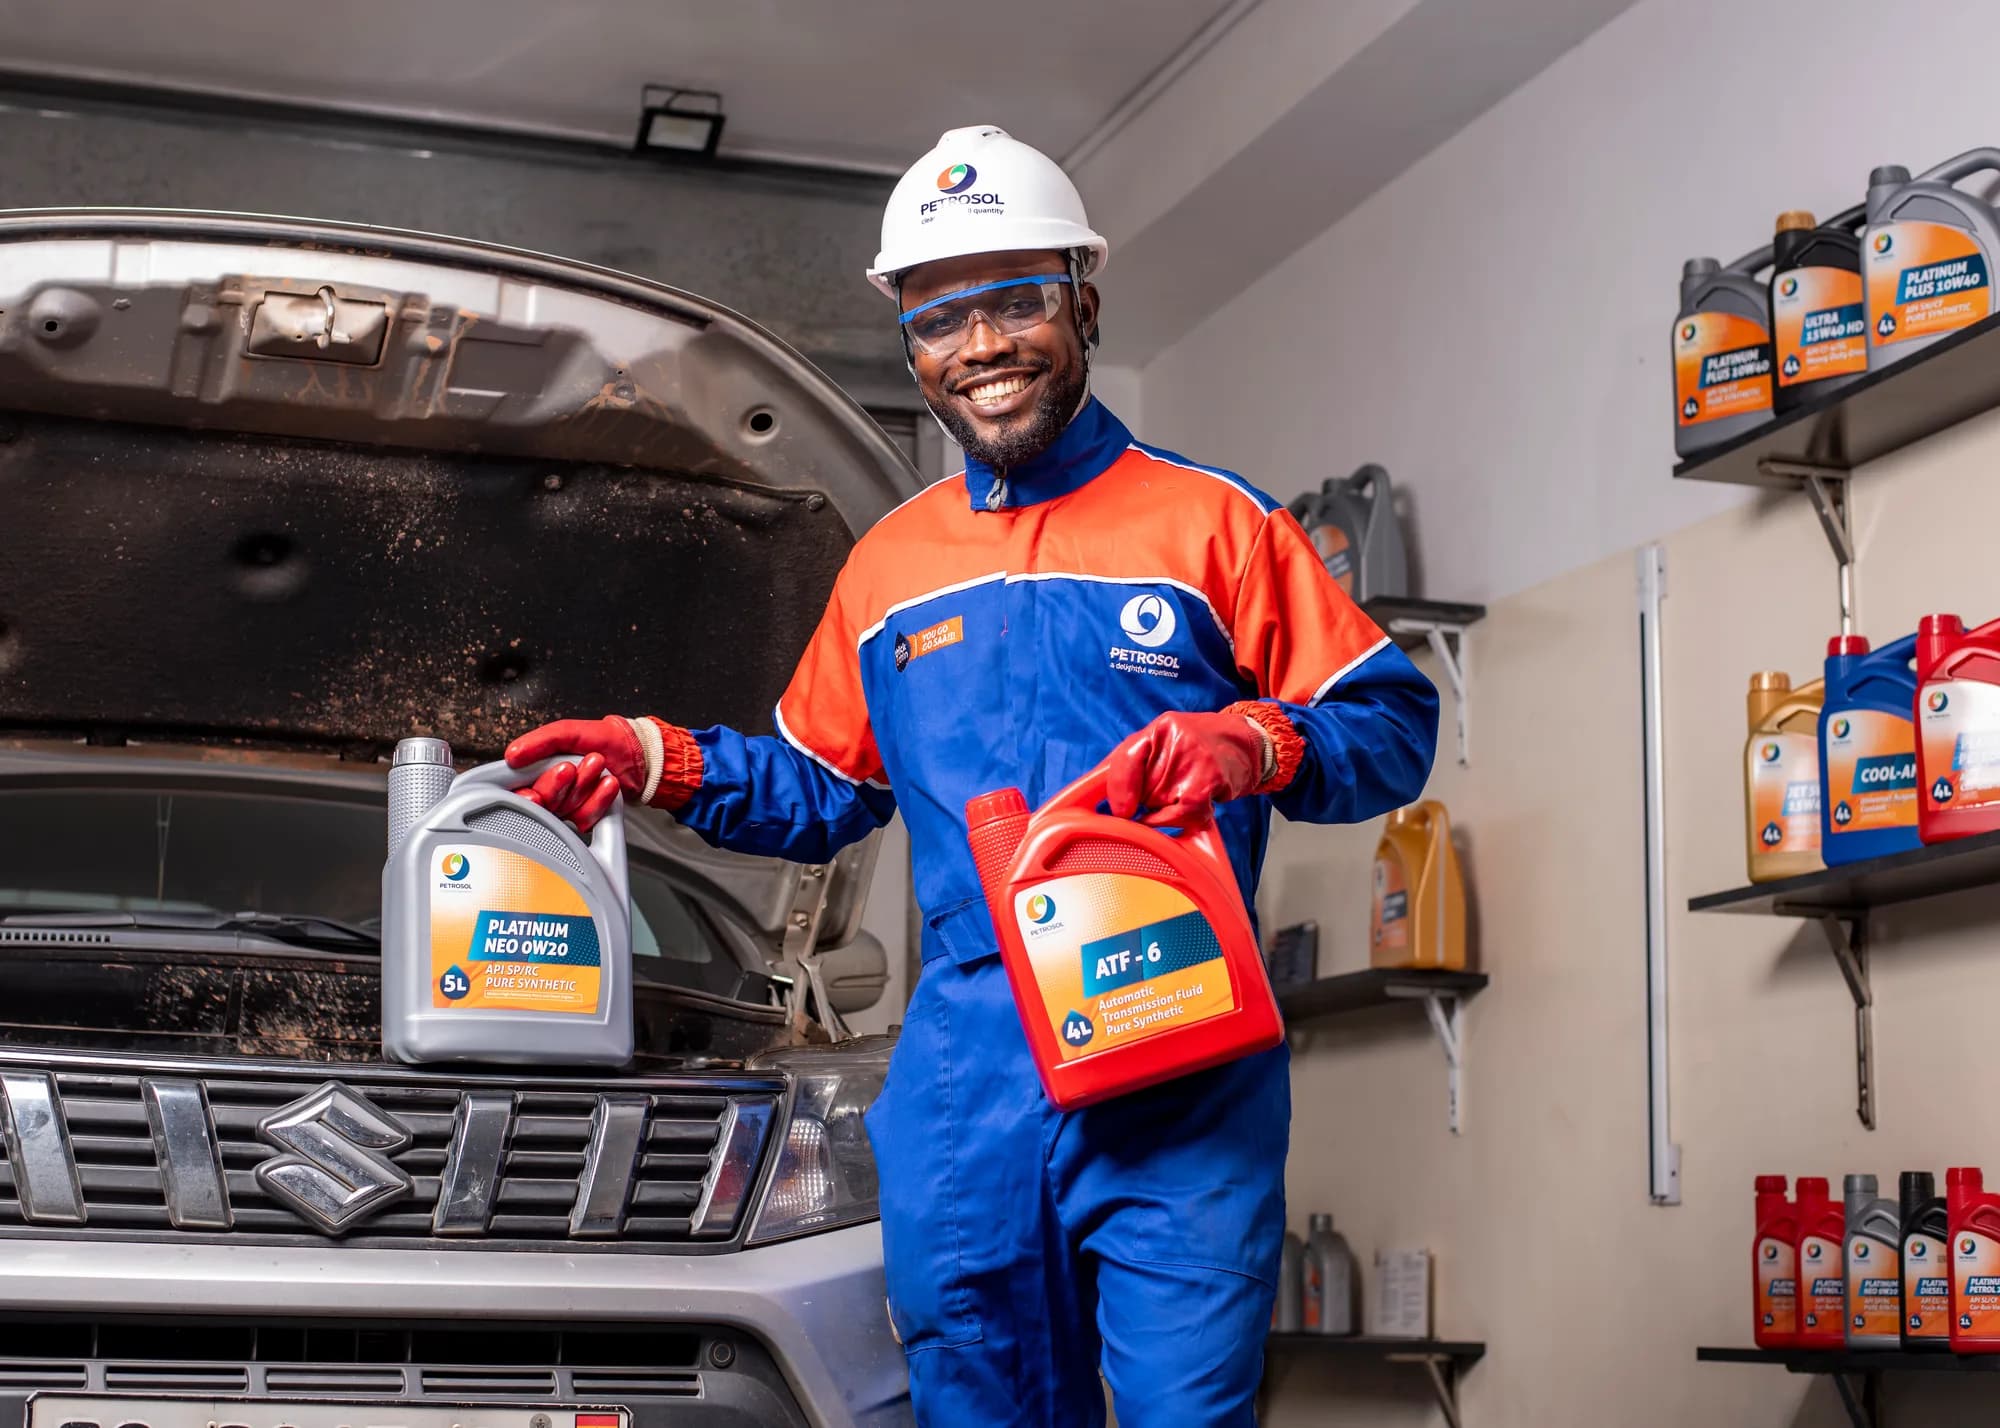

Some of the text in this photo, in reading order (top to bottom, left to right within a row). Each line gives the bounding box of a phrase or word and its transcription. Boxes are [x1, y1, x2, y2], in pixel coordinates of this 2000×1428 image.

[1907, 261, 1968, 285] PLATINUM
[1905, 273, 1980, 299] PLUS 10W40
[1805, 312, 1839, 329] ULTRA
[1879, 319, 1896, 333] 4L
[1706, 348, 1760, 369] PLATINUM
[1705, 366, 1730, 385] PLUS
[923, 624, 949, 642] YOU GO
[922, 642, 933, 651] GO
[1110, 646, 1180, 669] PETROSOL
[1933, 784, 1952, 798] 4L
[1835, 807, 1851, 821] 4L
[1763, 828, 1782, 842] 4L
[439, 882, 472, 890] PETROSOL
[488, 919, 568, 938] PLATINUM
[1030, 922, 1065, 936] PETROSOL
[484, 938, 568, 957] NEO 0W20
[1095, 950, 1130, 979] ATF
[1147, 941, 1161, 963] 6
[485, 964, 540, 977] API SP/RC
[443, 974, 467, 993] 5L
[485, 977, 577, 992] PURE SYNTHETIC
[1098, 986, 1155, 1011] Automatic
[1101, 984, 1203, 1023] Transmission Fluid
[1065, 1020, 1092, 1040] 4L
[1105, 1004, 1184, 1037] Pure Synthetic
[1969, 1286, 1994, 1294] PETROL
